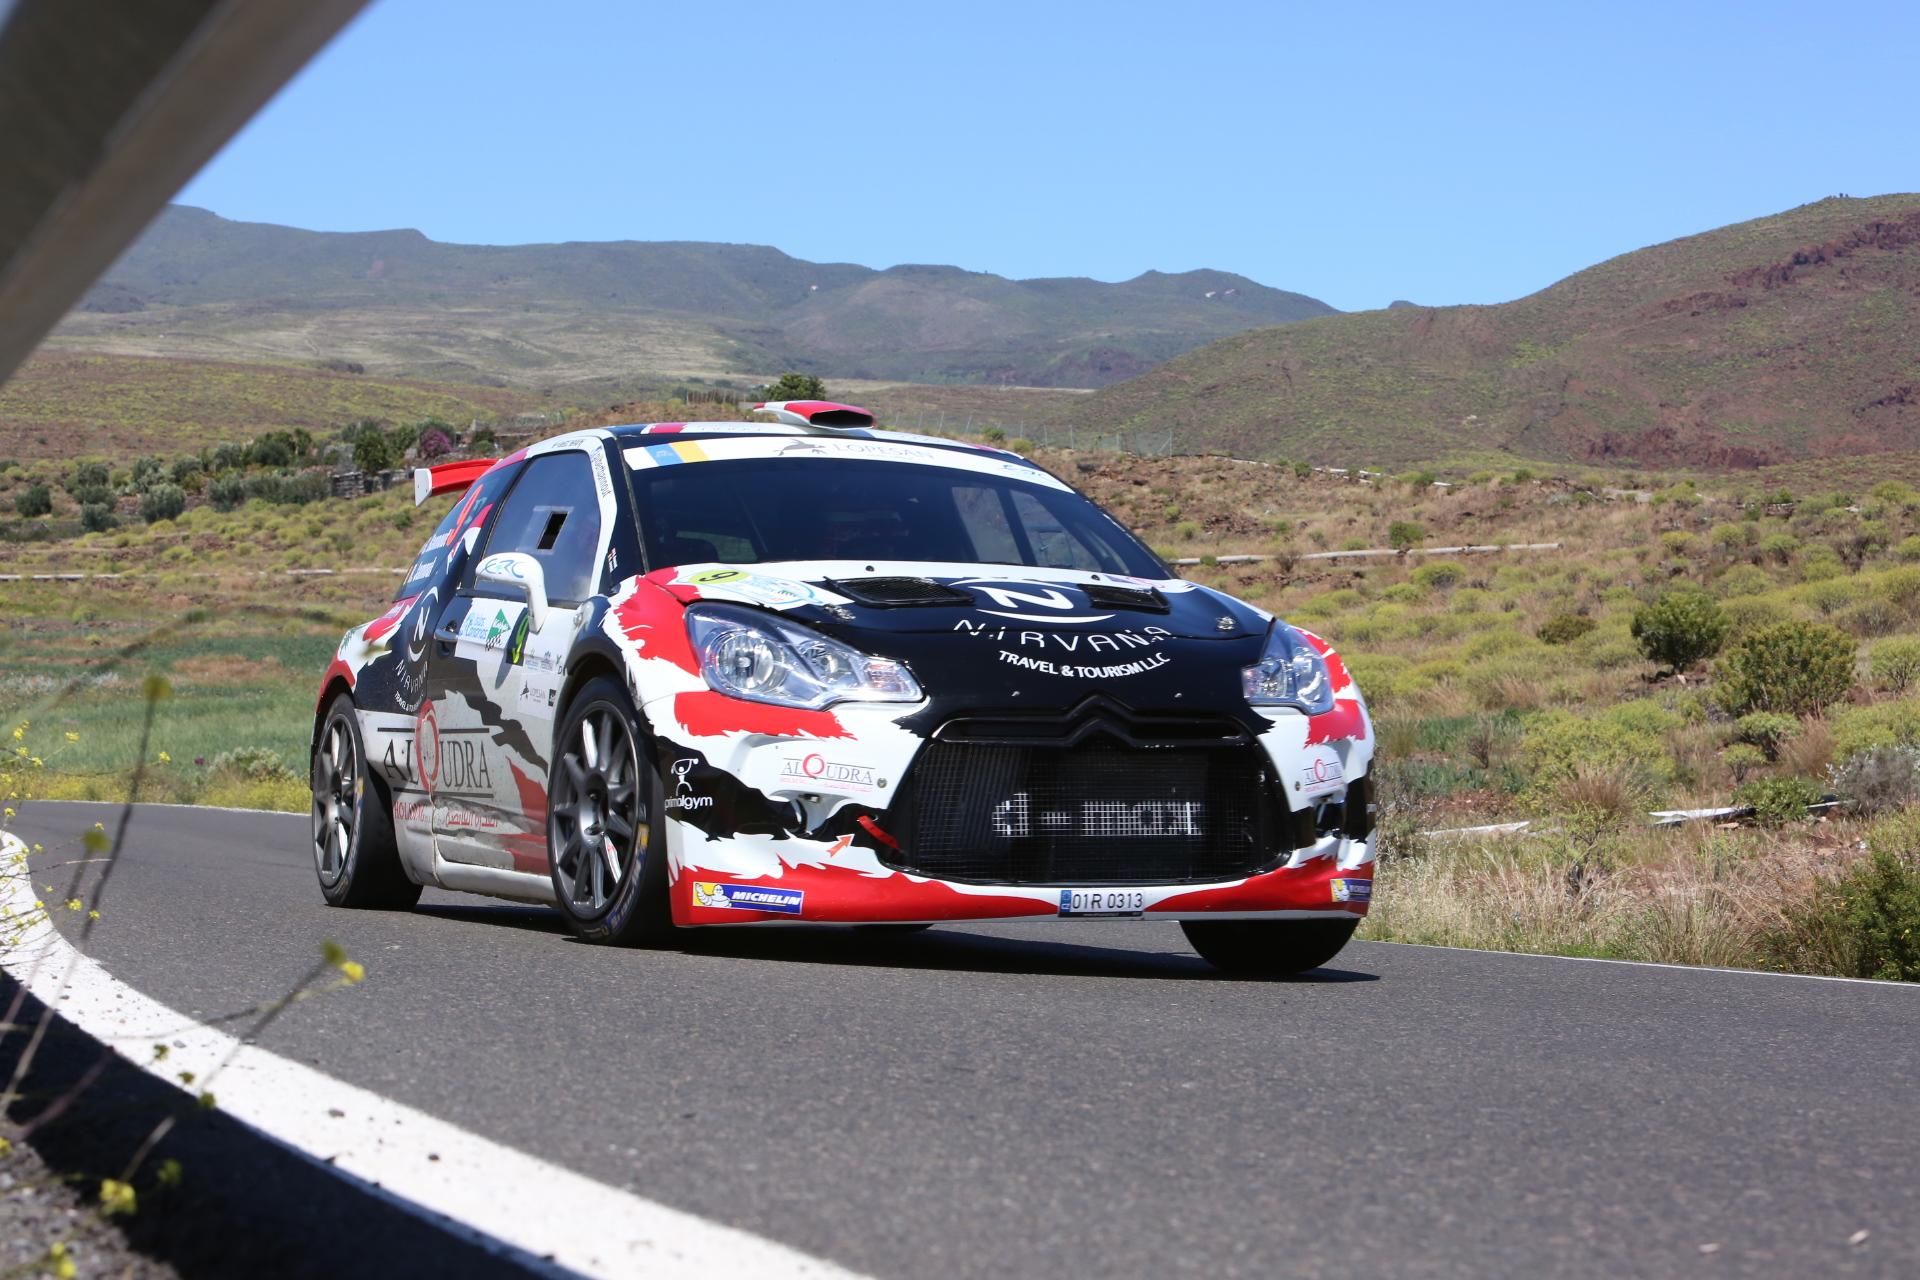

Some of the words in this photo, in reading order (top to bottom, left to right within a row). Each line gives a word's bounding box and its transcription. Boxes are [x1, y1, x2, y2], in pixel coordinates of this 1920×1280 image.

[999, 650, 1059, 675] TRAVEL
[1061, 665, 1074, 677] &
[1074, 661, 1143, 678] TOURISM
[1140, 652, 1171, 671] LLC
[731, 891, 801, 906] MICHELIN
[1072, 894, 1102, 909] 01R
[1107, 893, 1143, 908] 0313
